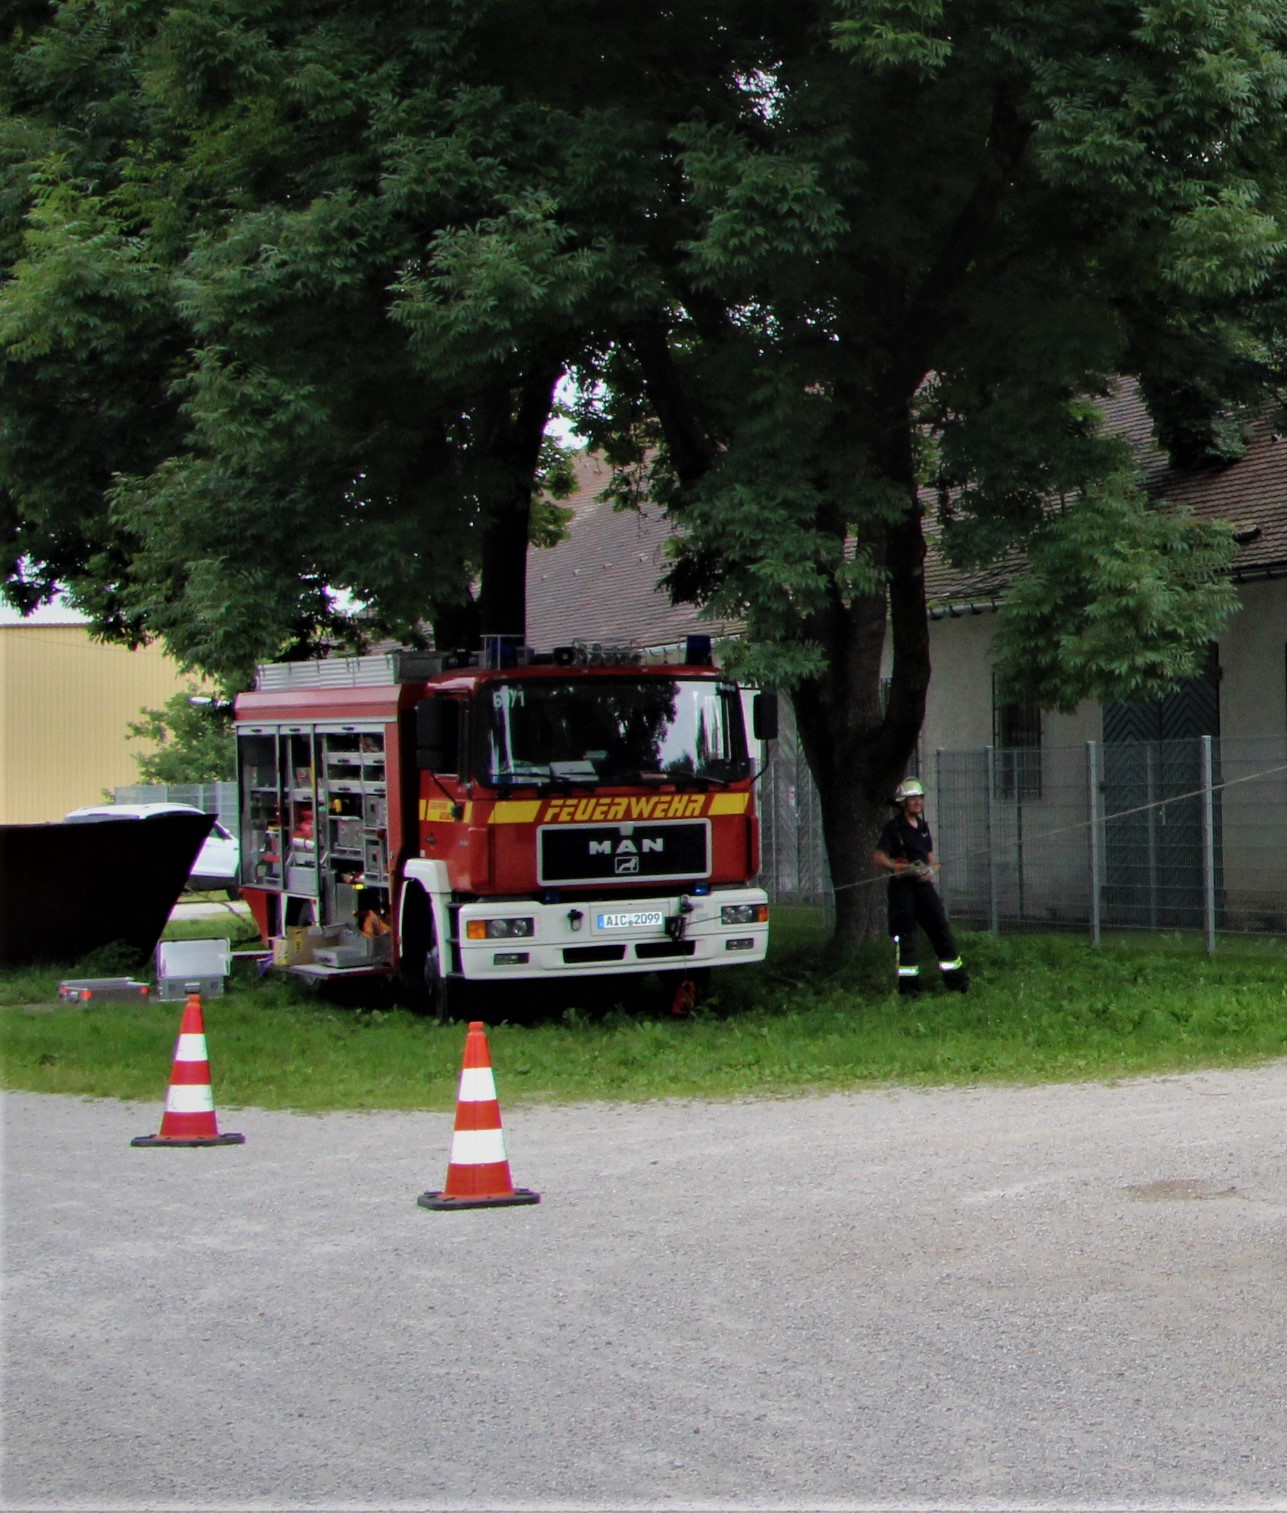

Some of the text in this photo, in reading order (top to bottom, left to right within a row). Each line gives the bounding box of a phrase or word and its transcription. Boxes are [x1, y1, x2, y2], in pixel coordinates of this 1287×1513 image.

[543, 794, 705, 822] FEUERWEHR
[589, 838, 664, 855] MAN
[606, 913, 660, 926] AIC 2099
